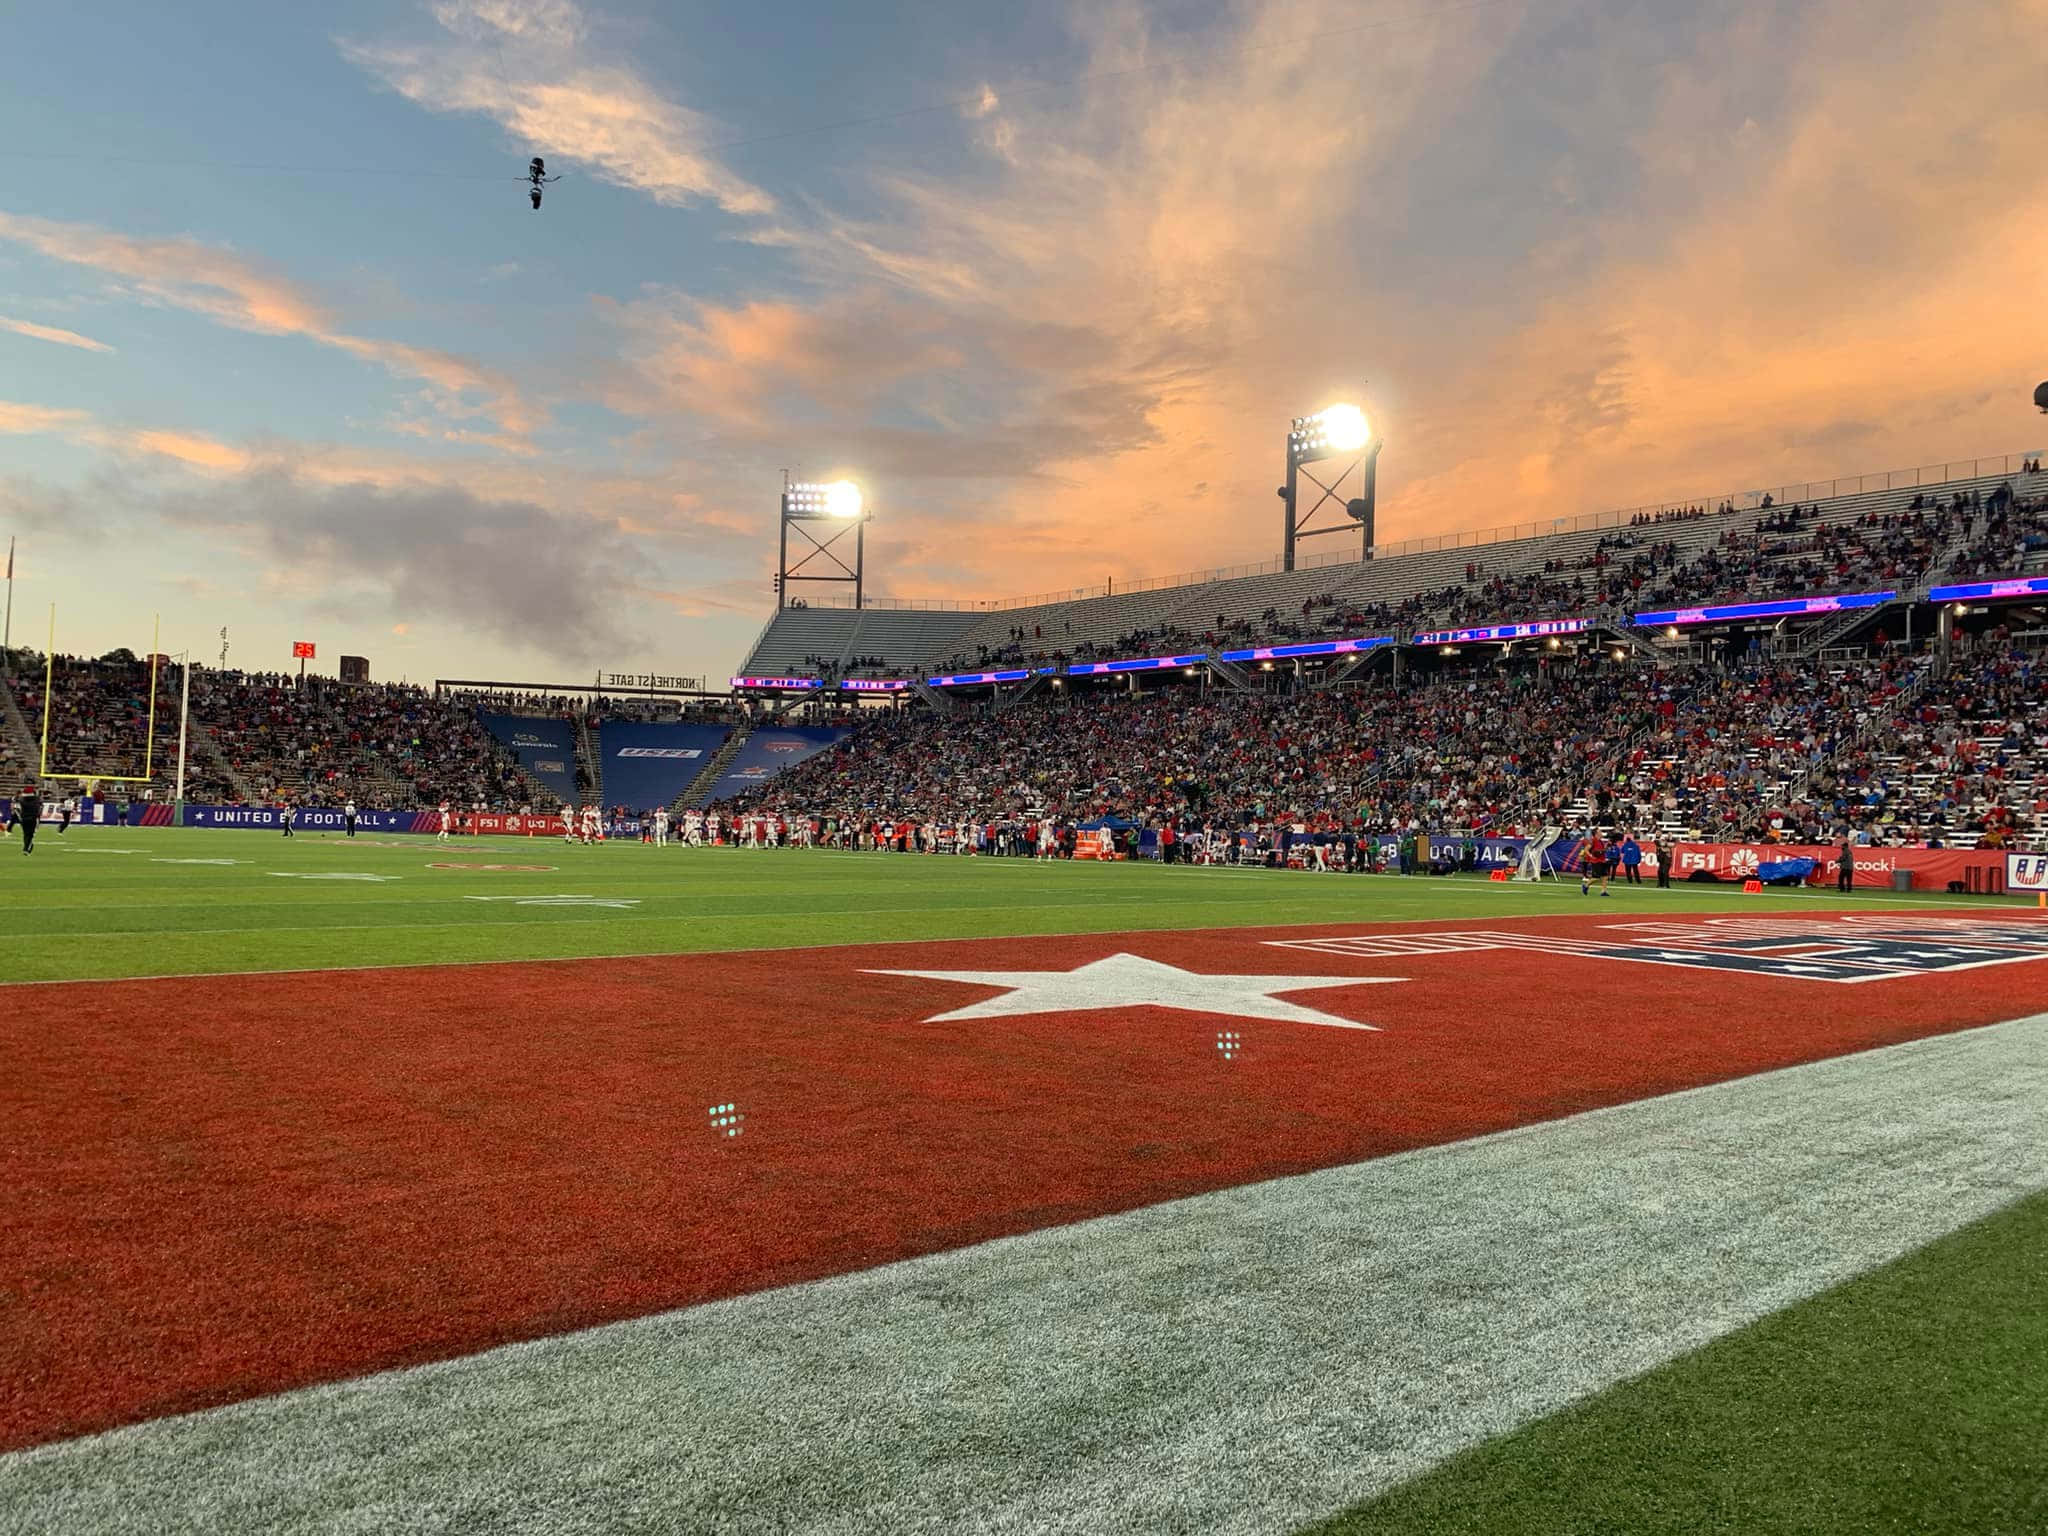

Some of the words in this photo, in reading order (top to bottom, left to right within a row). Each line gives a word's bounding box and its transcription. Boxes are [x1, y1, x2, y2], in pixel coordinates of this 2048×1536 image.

[214, 811, 272, 823] UNITED
[304, 813, 380, 826] FOOTALL
[480, 818, 499, 828] FS1
[1681, 853, 1716, 869] FS1
[1731, 865, 1758, 876] NBC
[1826, 858, 1889, 874] pecock
